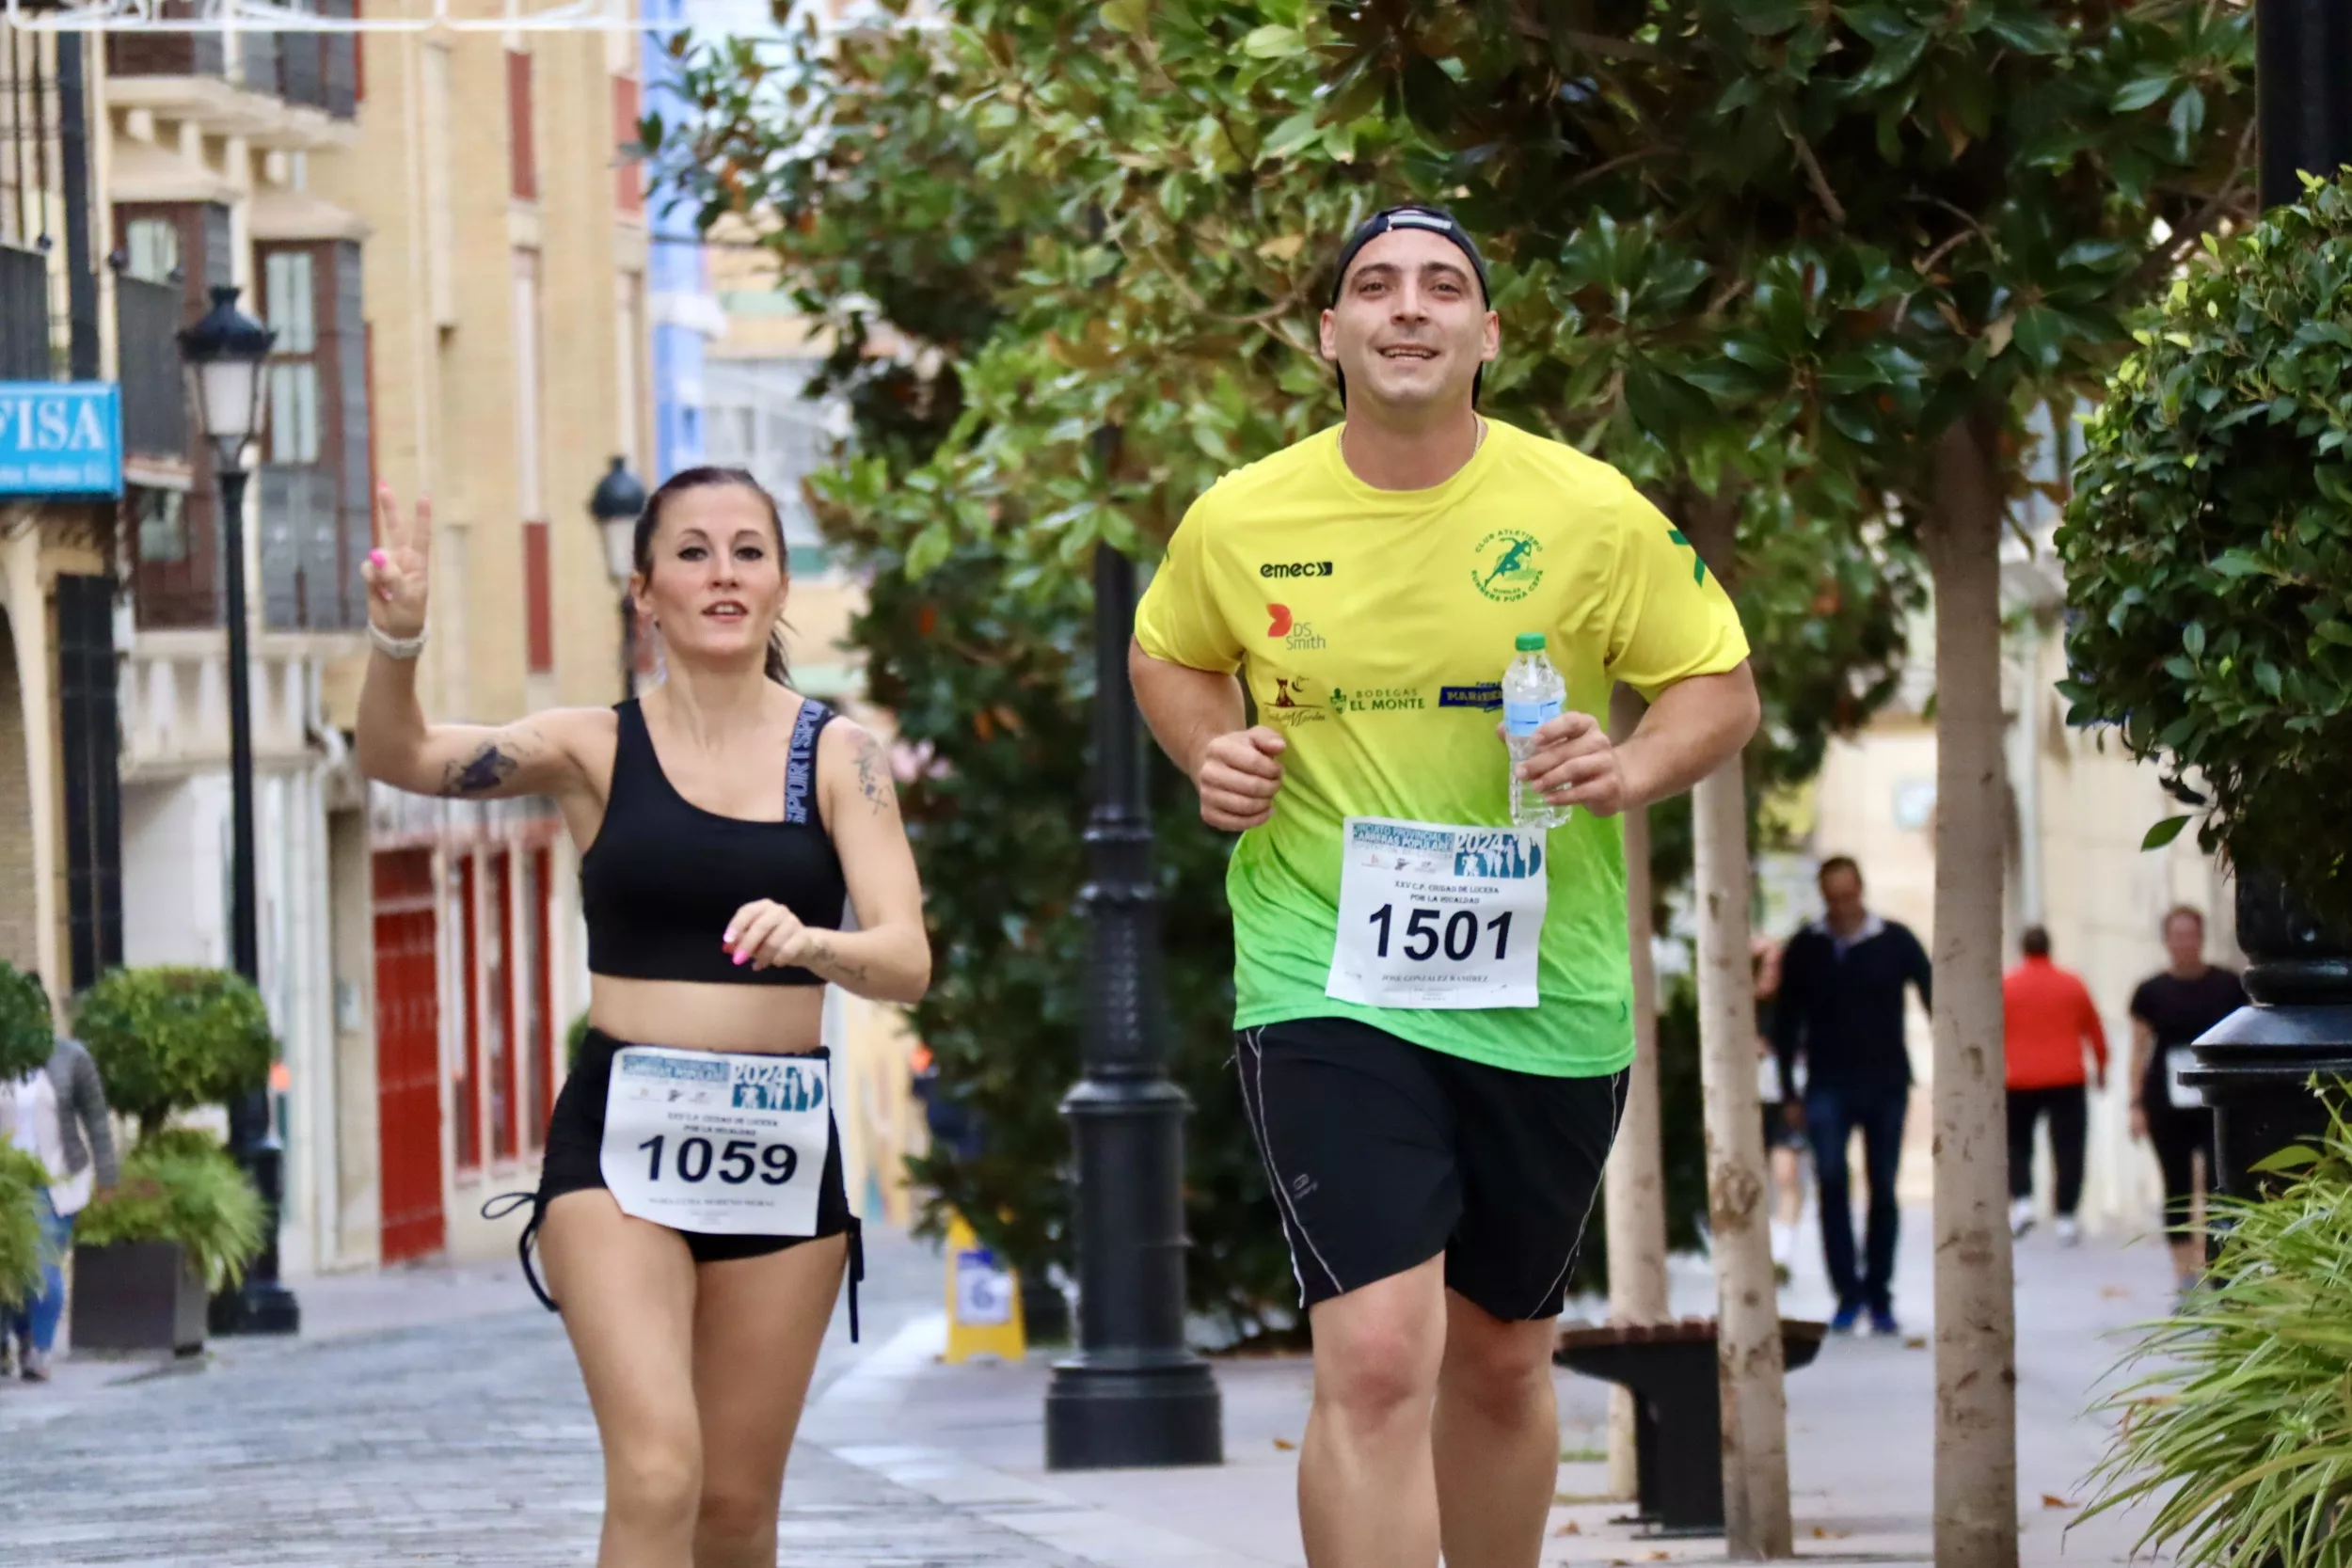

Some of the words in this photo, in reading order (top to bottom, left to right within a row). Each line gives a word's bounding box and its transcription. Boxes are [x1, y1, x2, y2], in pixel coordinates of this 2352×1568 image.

[1474, 533, 1494, 553] CLUB
[1503, 591, 1528, 602] PURA
[1293, 623, 1312, 638] DS
[1285, 635, 1327, 651] Smith
[1356, 689, 1418, 698] BODEGAS
[1350, 700, 1369, 711] EL
[1372, 698, 1426, 711] MONTE
[1456, 832, 1507, 854] 2024
[1369, 903, 1514, 961] 1501
[734, 1063, 788, 1085] 2024
[638, 1133, 798, 1186] 1059
